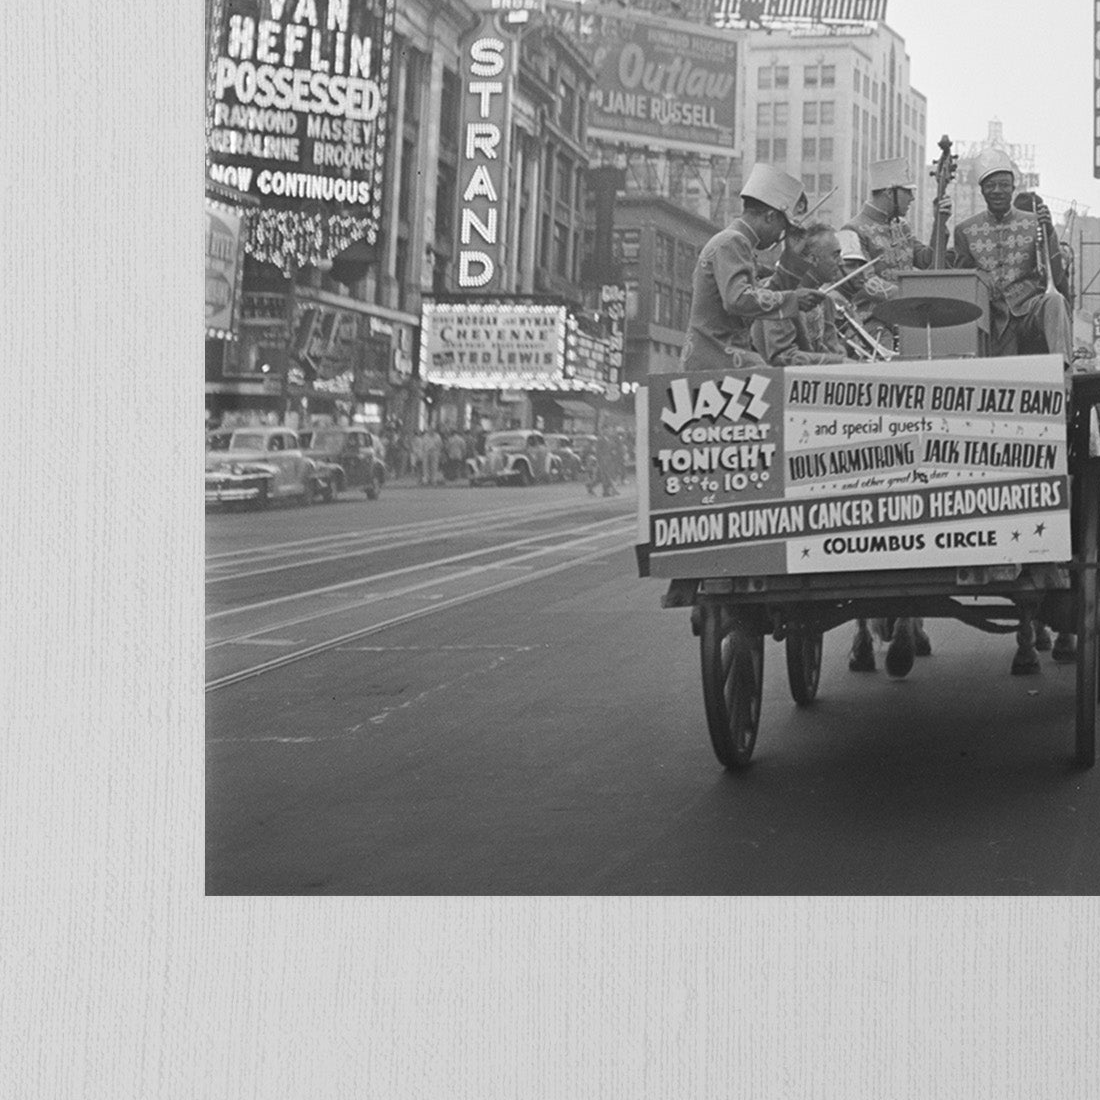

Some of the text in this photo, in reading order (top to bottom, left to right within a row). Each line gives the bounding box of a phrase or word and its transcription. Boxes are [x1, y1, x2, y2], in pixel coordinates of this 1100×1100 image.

[228, 15, 372, 78] HEFLIN
[215, 56, 382, 122] POSSESSED
[618, 43, 735, 100] Outlaw
[306, 113, 373, 145] MASSEY
[603, 89, 648, 119] JANE
[650, 97, 720, 129] RUSSELL
[458, 37, 505, 288] STRAND
[210, 163, 371, 205] NOW CONTINUOUS
[439, 326, 549, 345] CHEYENNE
[660, 373, 772, 433] JAZZ
[789, 380, 1064, 416] ART HODES RIVER BOAT JAZZ BAND
[681, 423, 772, 444] CONCERT
[815, 416, 934, 440] and special guests
[657, 443, 777, 473] TONIGHT
[788, 439, 1059, 481] LOUIS ARMSTRONG JACK TEAGARDEN
[700, 476, 719, 492] to
[654, 480, 1062, 548] DAMON RUNYAN CANCER FUND HEADQUARTERS
[823, 530, 998, 556] COLUMBUS CIRCLE
